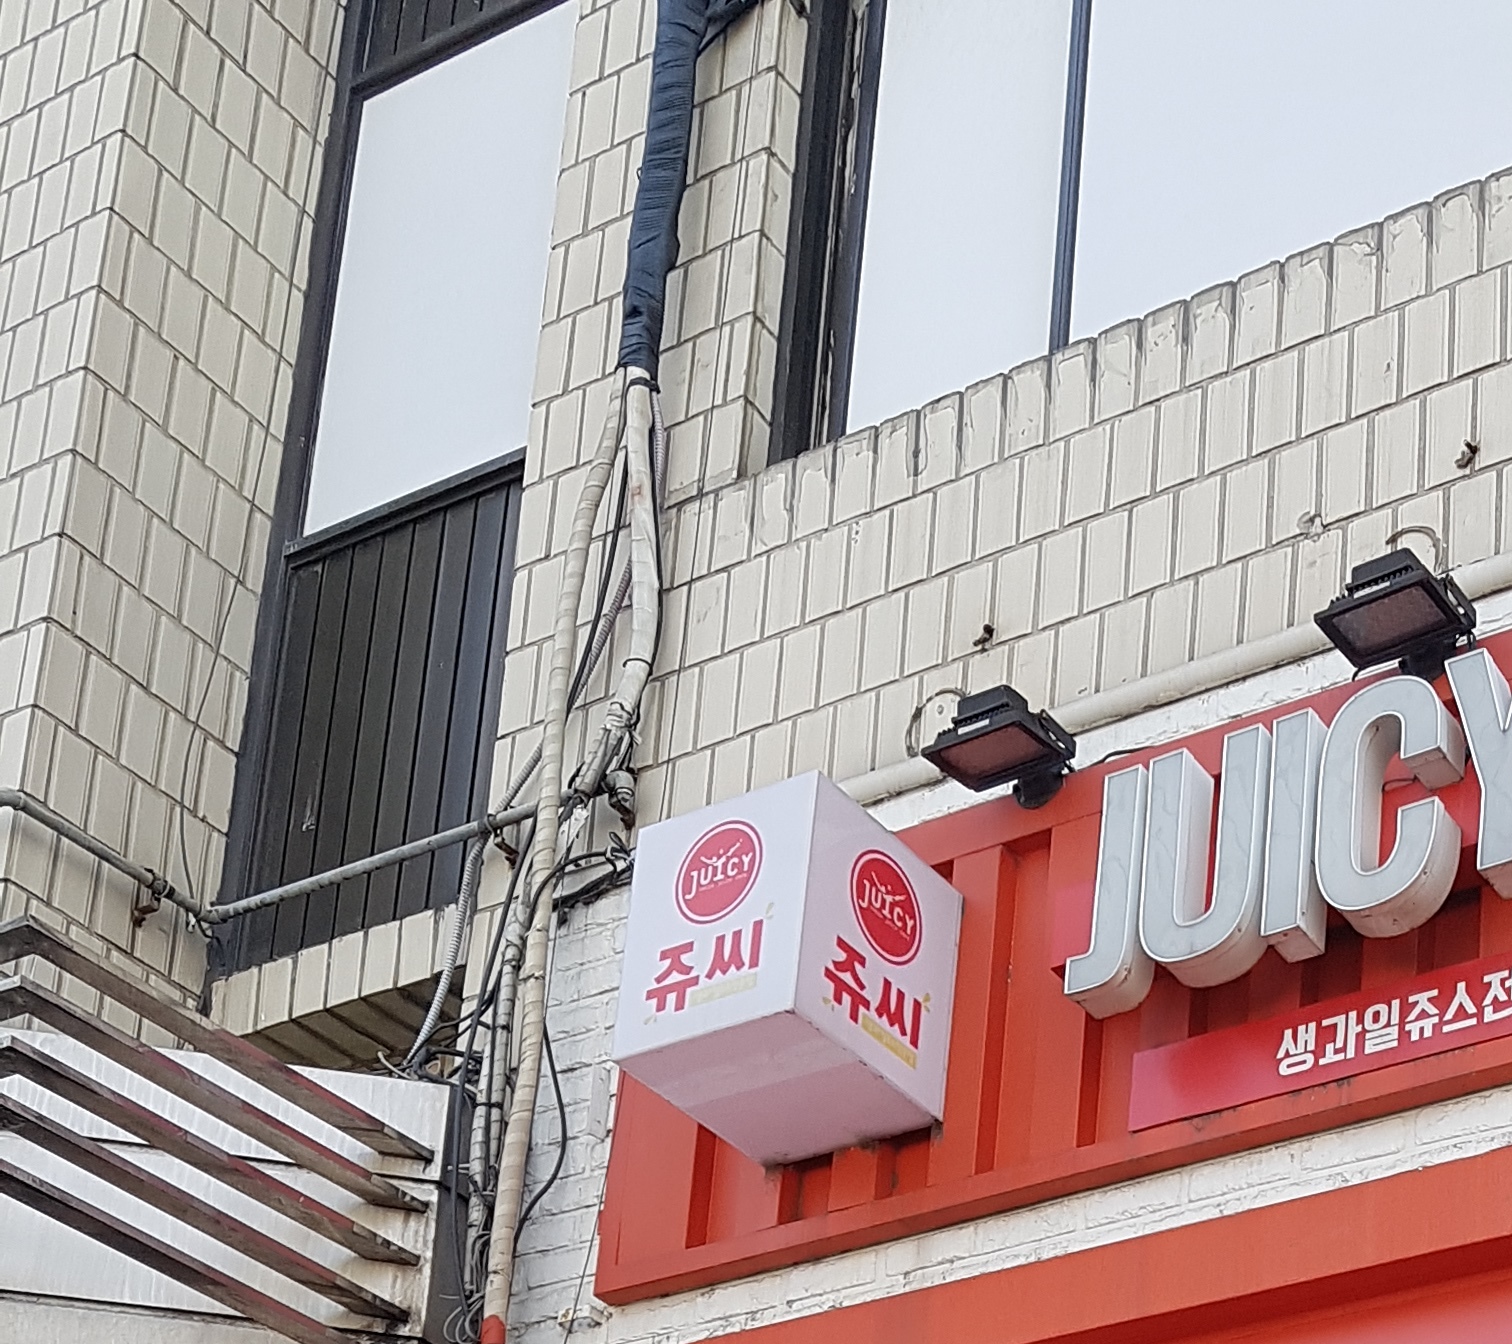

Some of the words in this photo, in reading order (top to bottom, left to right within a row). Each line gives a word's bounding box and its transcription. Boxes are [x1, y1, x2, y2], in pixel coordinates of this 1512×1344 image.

[684, 850, 754, 900] JUICY
[858, 879, 915, 936] JUICY
[646, 919, 764, 1013] 쥬씨
[823, 935, 922, 1051] 쥬씨
